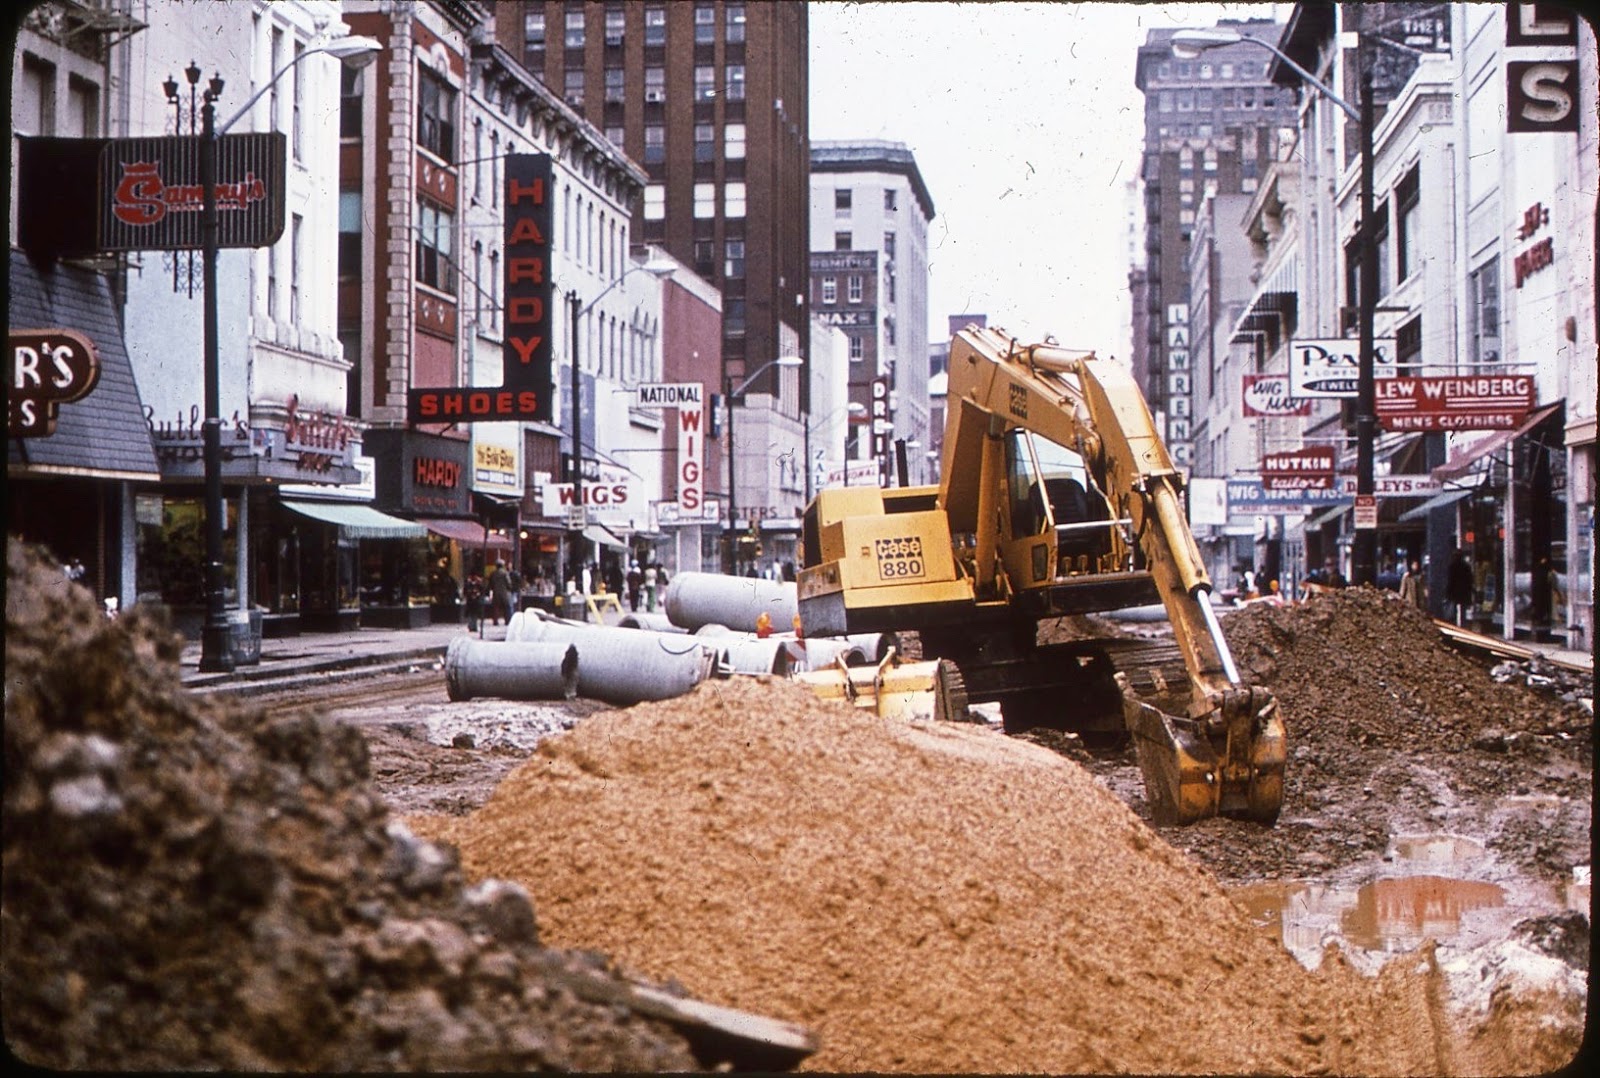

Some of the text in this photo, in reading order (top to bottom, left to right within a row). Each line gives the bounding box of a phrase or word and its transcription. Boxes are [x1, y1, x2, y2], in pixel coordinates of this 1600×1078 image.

[508, 177, 545, 364] HARDY
[640, 386, 701, 403] NATIONAL
[1253, 380, 1283, 395] WIG
[1313, 381, 1359, 391] JEWELE
[1374, 378, 1530, 399] LEW WEINBERG
[420, 391, 537, 415] SHOES
[141, 404, 248, 440] Butlr's
[1438, 414, 1514, 427] CLOTHIERS
[680, 410, 701, 510] WIGS
[1265, 457, 1331, 470] HUTKIN
[415, 457, 462, 488] HARDY
[814, 450, 826, 494] ZAL
[1270, 477, 1327, 488] tailors
[559, 485, 628, 506] WIGS
[1228, 485, 1259, 500] WIG
[883, 560, 921, 577] 880
